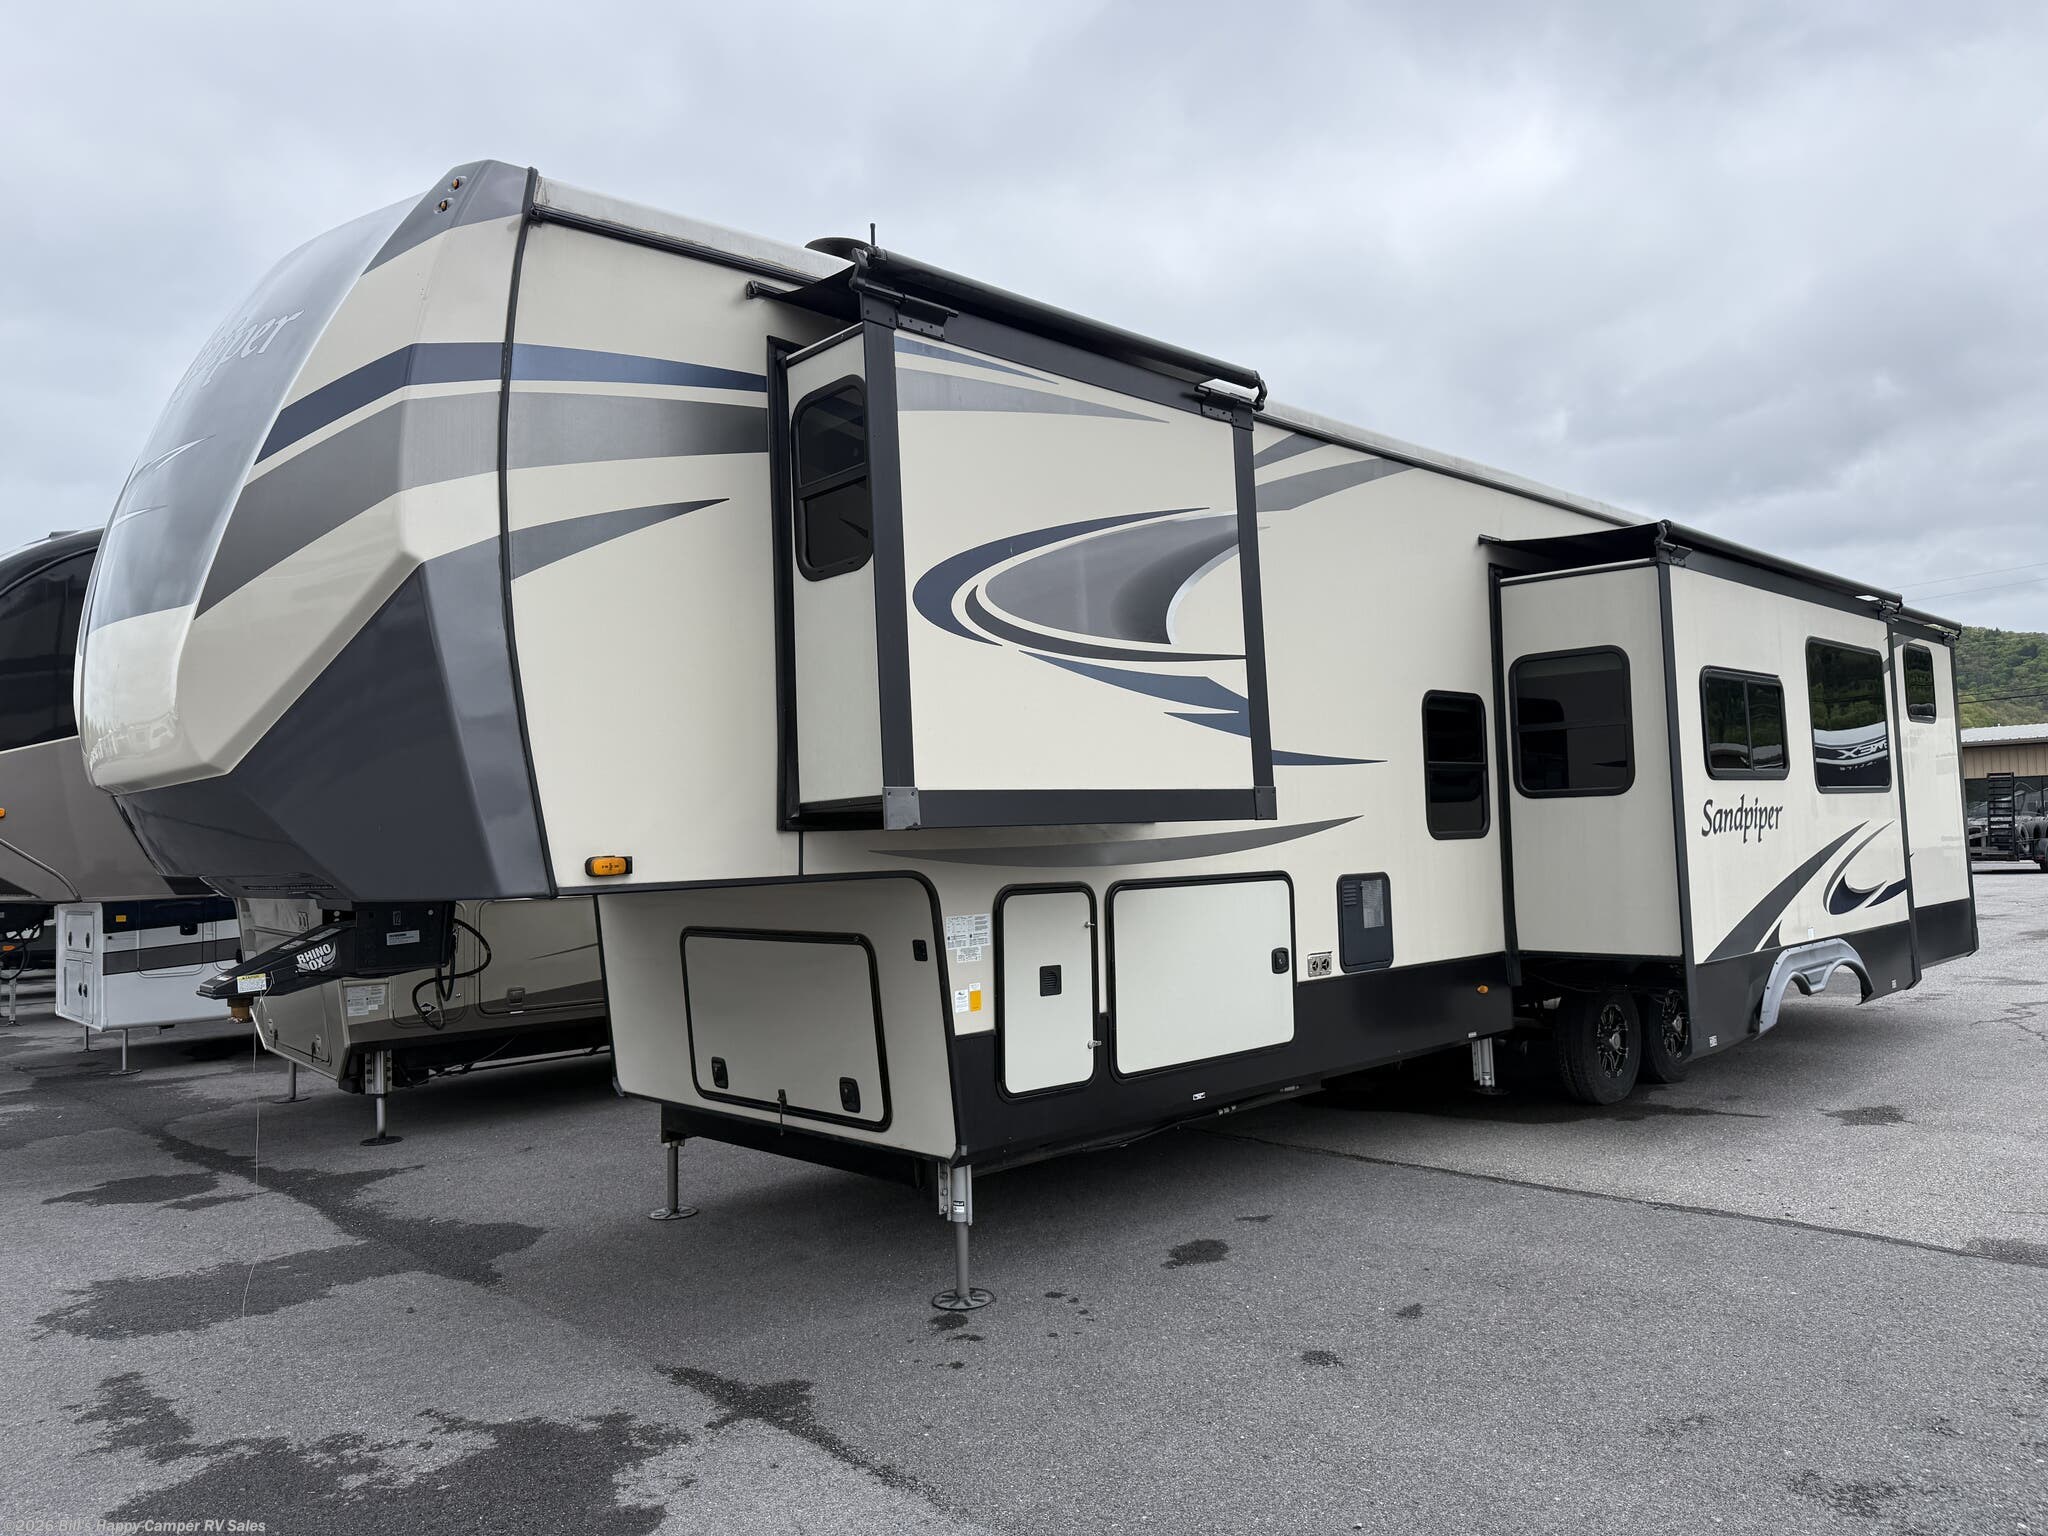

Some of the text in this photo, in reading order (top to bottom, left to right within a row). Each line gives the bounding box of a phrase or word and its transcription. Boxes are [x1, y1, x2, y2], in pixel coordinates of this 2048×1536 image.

[1701, 793, 1783, 844] Sandpiper
[296, 943, 331, 964] RHINO
[308, 956, 326, 970] OX
